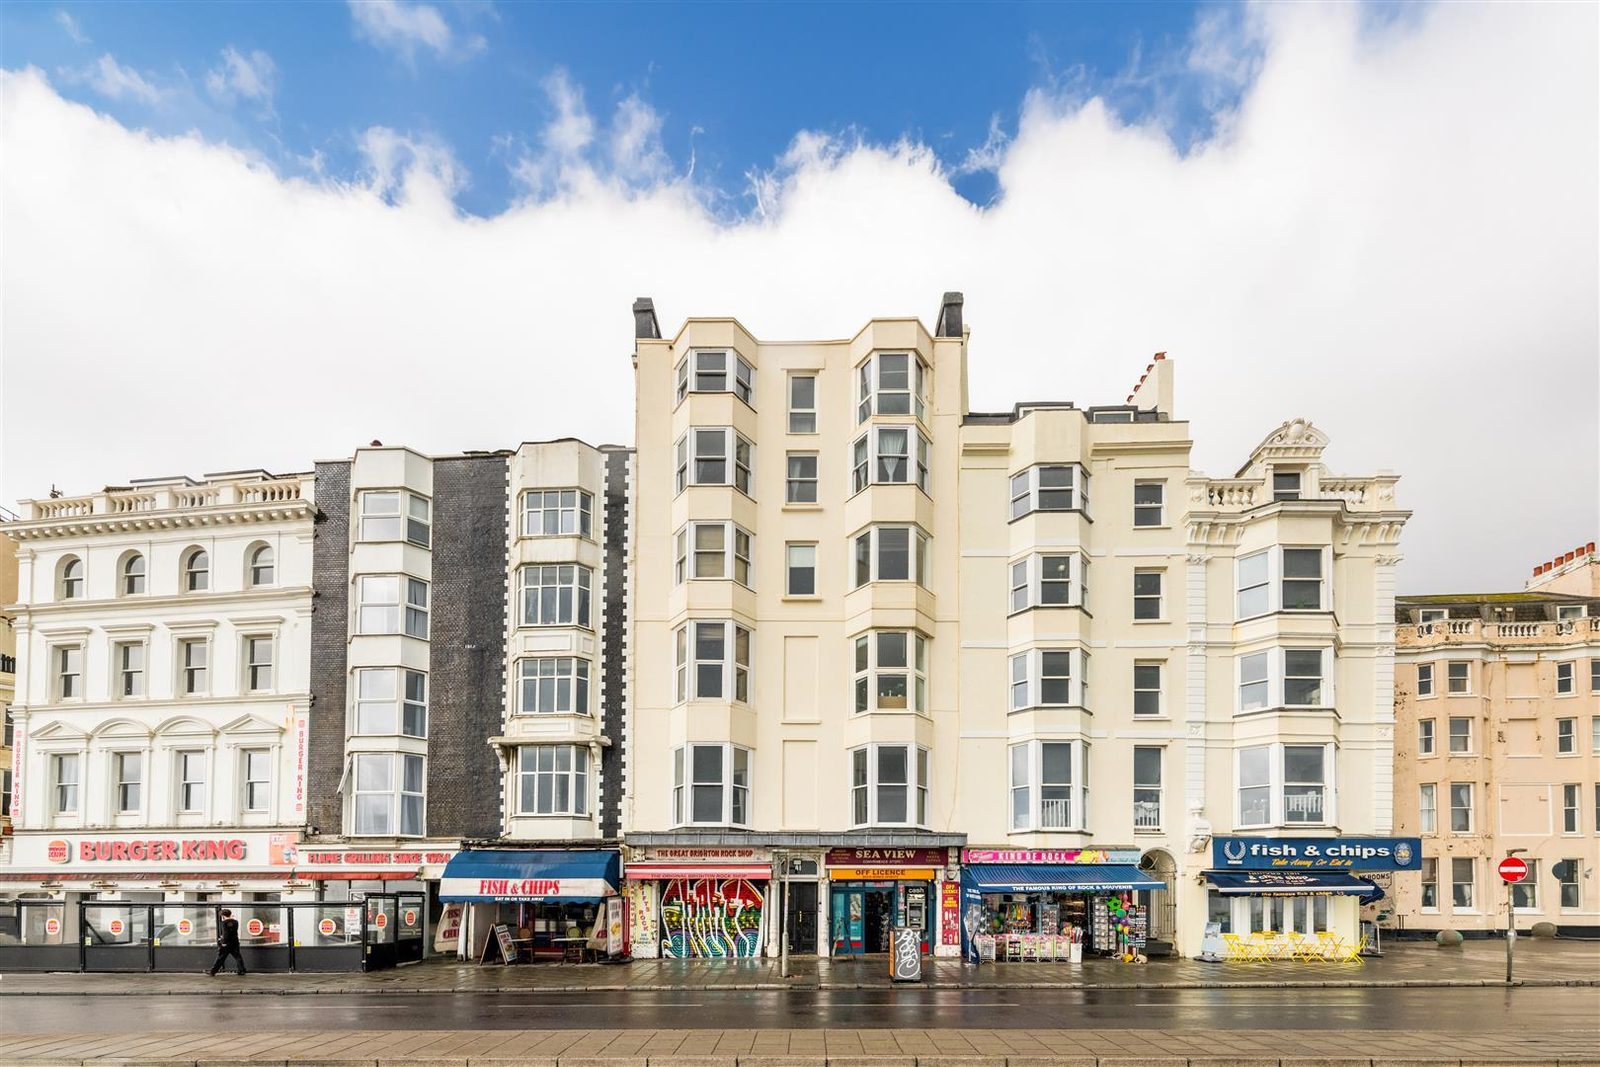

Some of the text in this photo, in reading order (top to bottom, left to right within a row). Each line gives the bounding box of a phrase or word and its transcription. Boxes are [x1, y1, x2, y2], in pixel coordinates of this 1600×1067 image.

[80, 839, 246, 861] BURGER KING
[657, 849, 754, 857] THE GREAT BRIGHTON ROCK SHOP
[855, 849, 880, 859] SEA
[883, 849, 916, 859] VIEW
[1250, 844, 1390, 859] fish & chips
[308, 853, 341, 864] FLAME
[344, 853, 391, 864] GRILLING
[393, 853, 422, 864] SINCE
[998, 852, 1022, 860] KING
[1025, 852, 1037, 860] OF
[1041, 852, 1066, 860] ROCK
[1271, 858, 1288, 866] Take
[1290, 858, 1313, 867] Away
[1329, 858, 1345, 866] Eat
[479, 879, 560, 895] FISH & CHIPS
